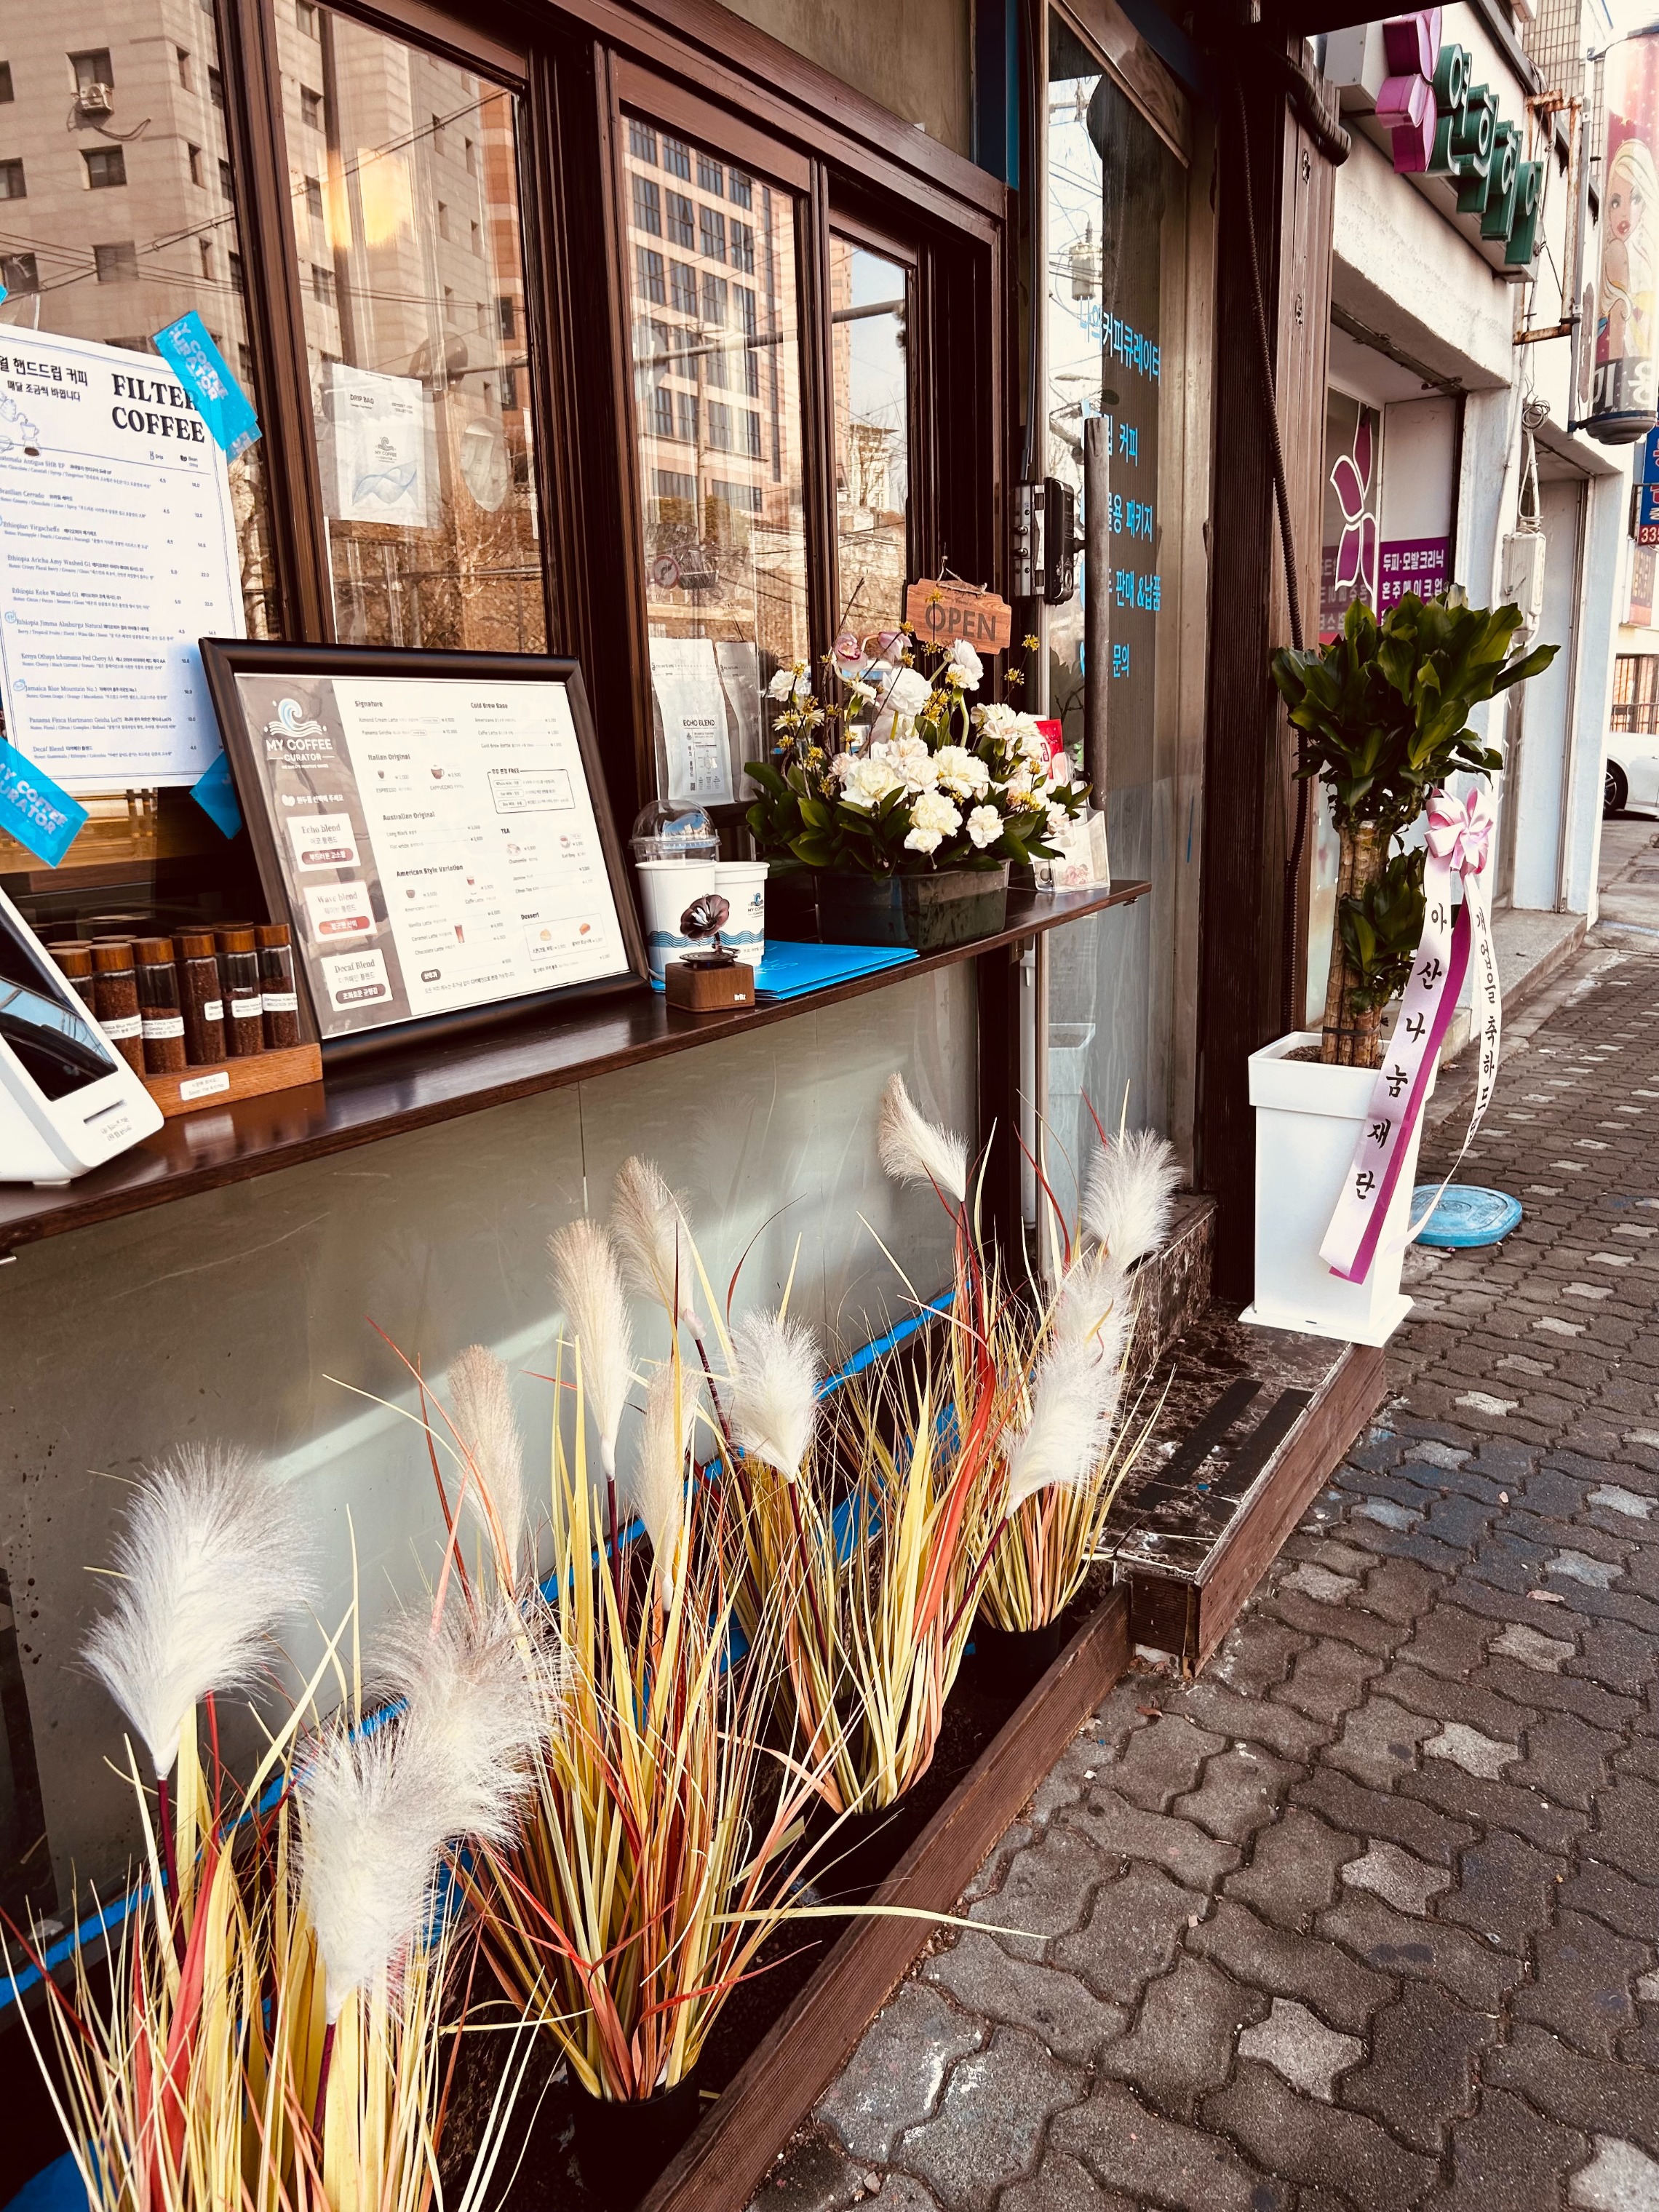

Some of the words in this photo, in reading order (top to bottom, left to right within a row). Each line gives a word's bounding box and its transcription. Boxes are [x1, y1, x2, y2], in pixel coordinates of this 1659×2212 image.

[13, 358, 62, 381] 핸드드립
[66, 367, 88, 386] 커피
[7, 380, 23, 391] 매달
[111, 373, 199, 411] FILTER
[111, 405, 205, 443] COFFEE
[1119, 422, 1138, 468] 커피
[1126, 499, 1153, 543] 패키지
[1116, 568, 1134, 608] 판매
[926, 603, 996, 641] OPEN
[1113, 644, 1130, 677] 문의
[699, 719, 715, 727] BLEND
[266, 739, 283, 751] MY
[287, 739, 333, 751] COFFEE
[285, 753, 322, 762] CURATOR
[389, 753, 410, 761] Original
[383, 813, 412, 821] Australian
[413, 811, 435, 819] Original
[301, 825, 319, 834] Echo
[321, 824, 341, 832] blend
[397, 870, 423, 878] American
[423, 867, 438, 875] Style
[439, 864, 464, 872] Variation
[317, 894, 337, 904] Wave
[338, 891, 358, 902] blend
[520, 912, 539, 920] Dessert
[1476, 907, 1497, 1004] 개업을
[335, 963, 354, 974] Decaf
[356, 959, 375, 968] Blend
[1354, 902, 1447, 1201] 아산나눔재단
